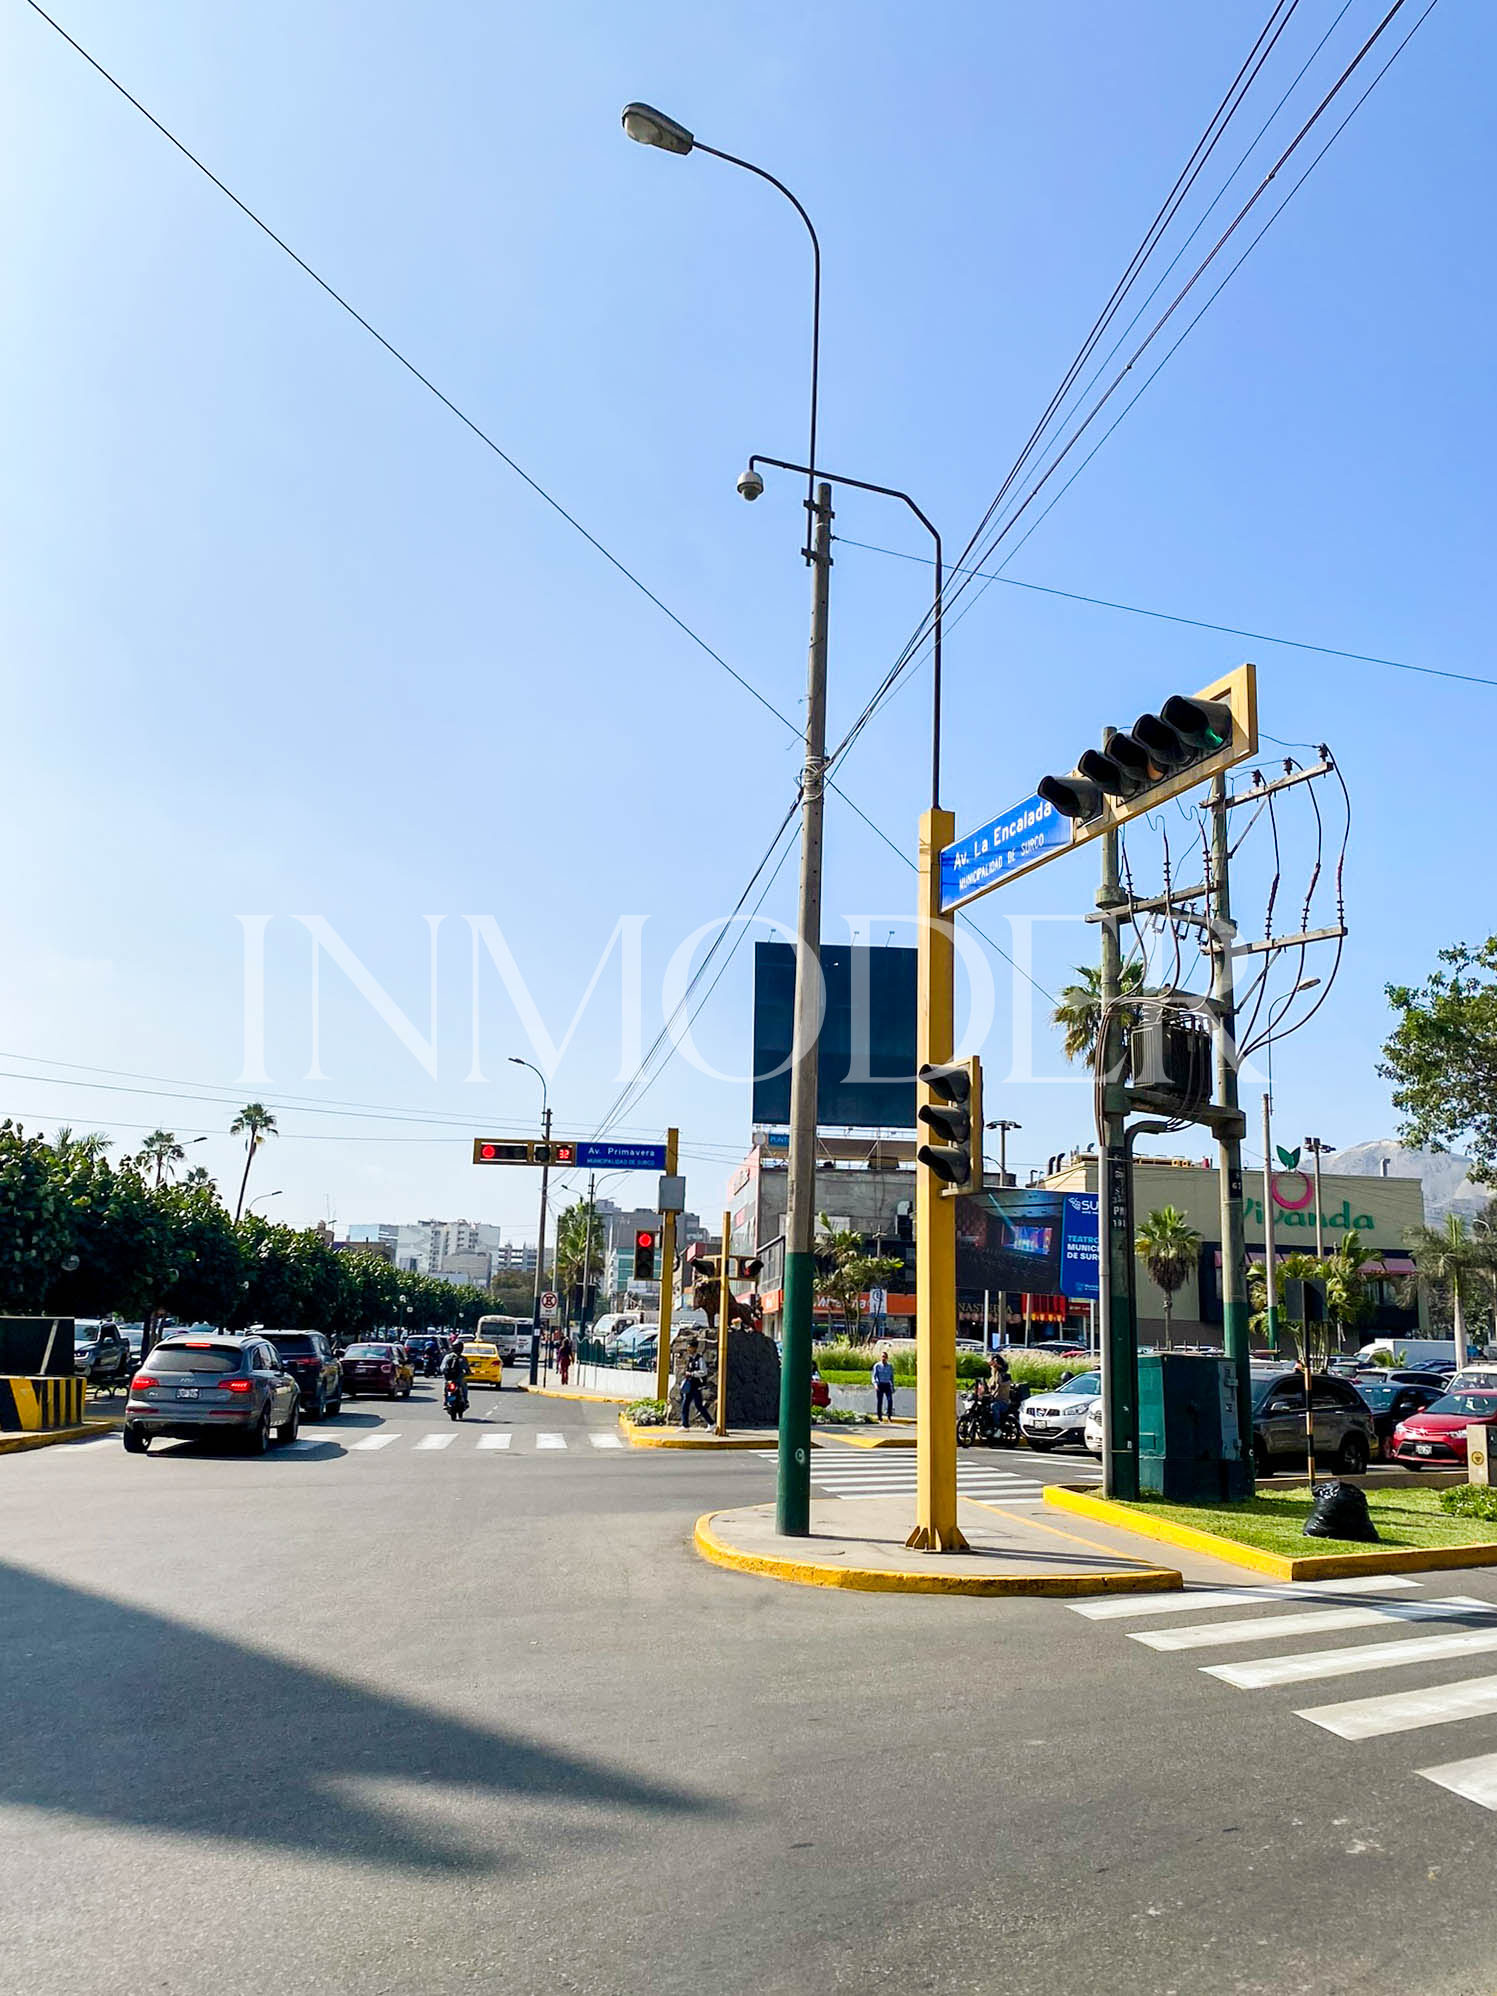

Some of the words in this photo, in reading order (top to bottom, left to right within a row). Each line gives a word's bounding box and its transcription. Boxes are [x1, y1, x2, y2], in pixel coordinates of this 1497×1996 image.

[954, 851, 970, 870] Av.
[974, 840, 989, 858] La
[993, 801, 1052, 847] Encalada
[959, 855, 1003, 889] MUNICIPALIDAD
[1007, 848, 1016, 864] DE
[1020, 833, 1045, 856] SURCO
[608, 1147, 655, 1157] Primavera
